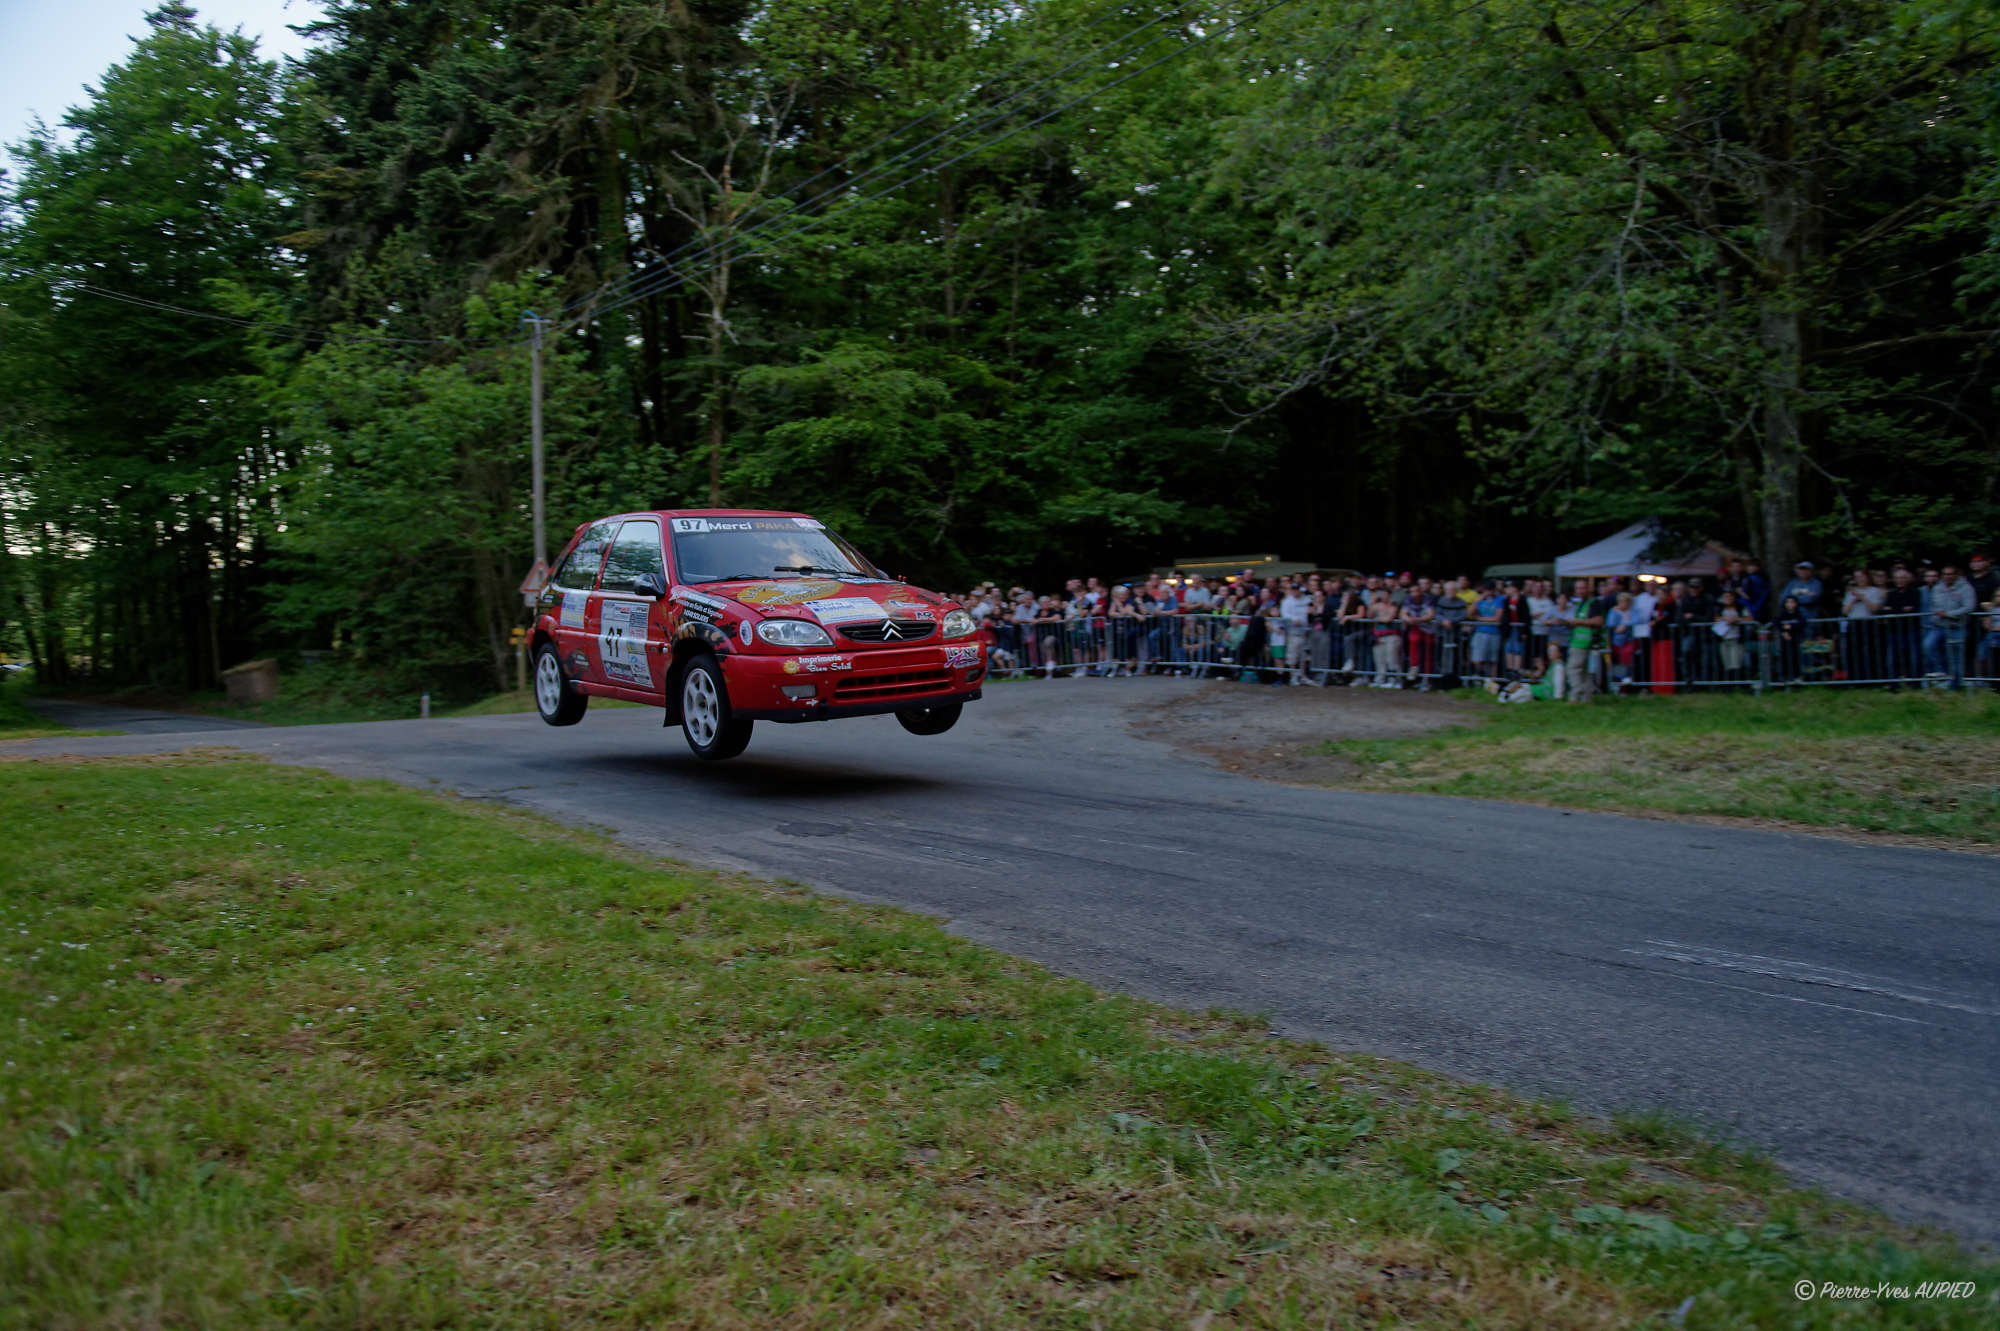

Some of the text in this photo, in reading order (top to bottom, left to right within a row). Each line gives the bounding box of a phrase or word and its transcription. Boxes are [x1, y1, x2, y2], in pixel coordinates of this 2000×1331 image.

[679, 519, 701, 530] 97
[708, 522, 752, 530] Merci
[605, 627, 623, 657] 97
